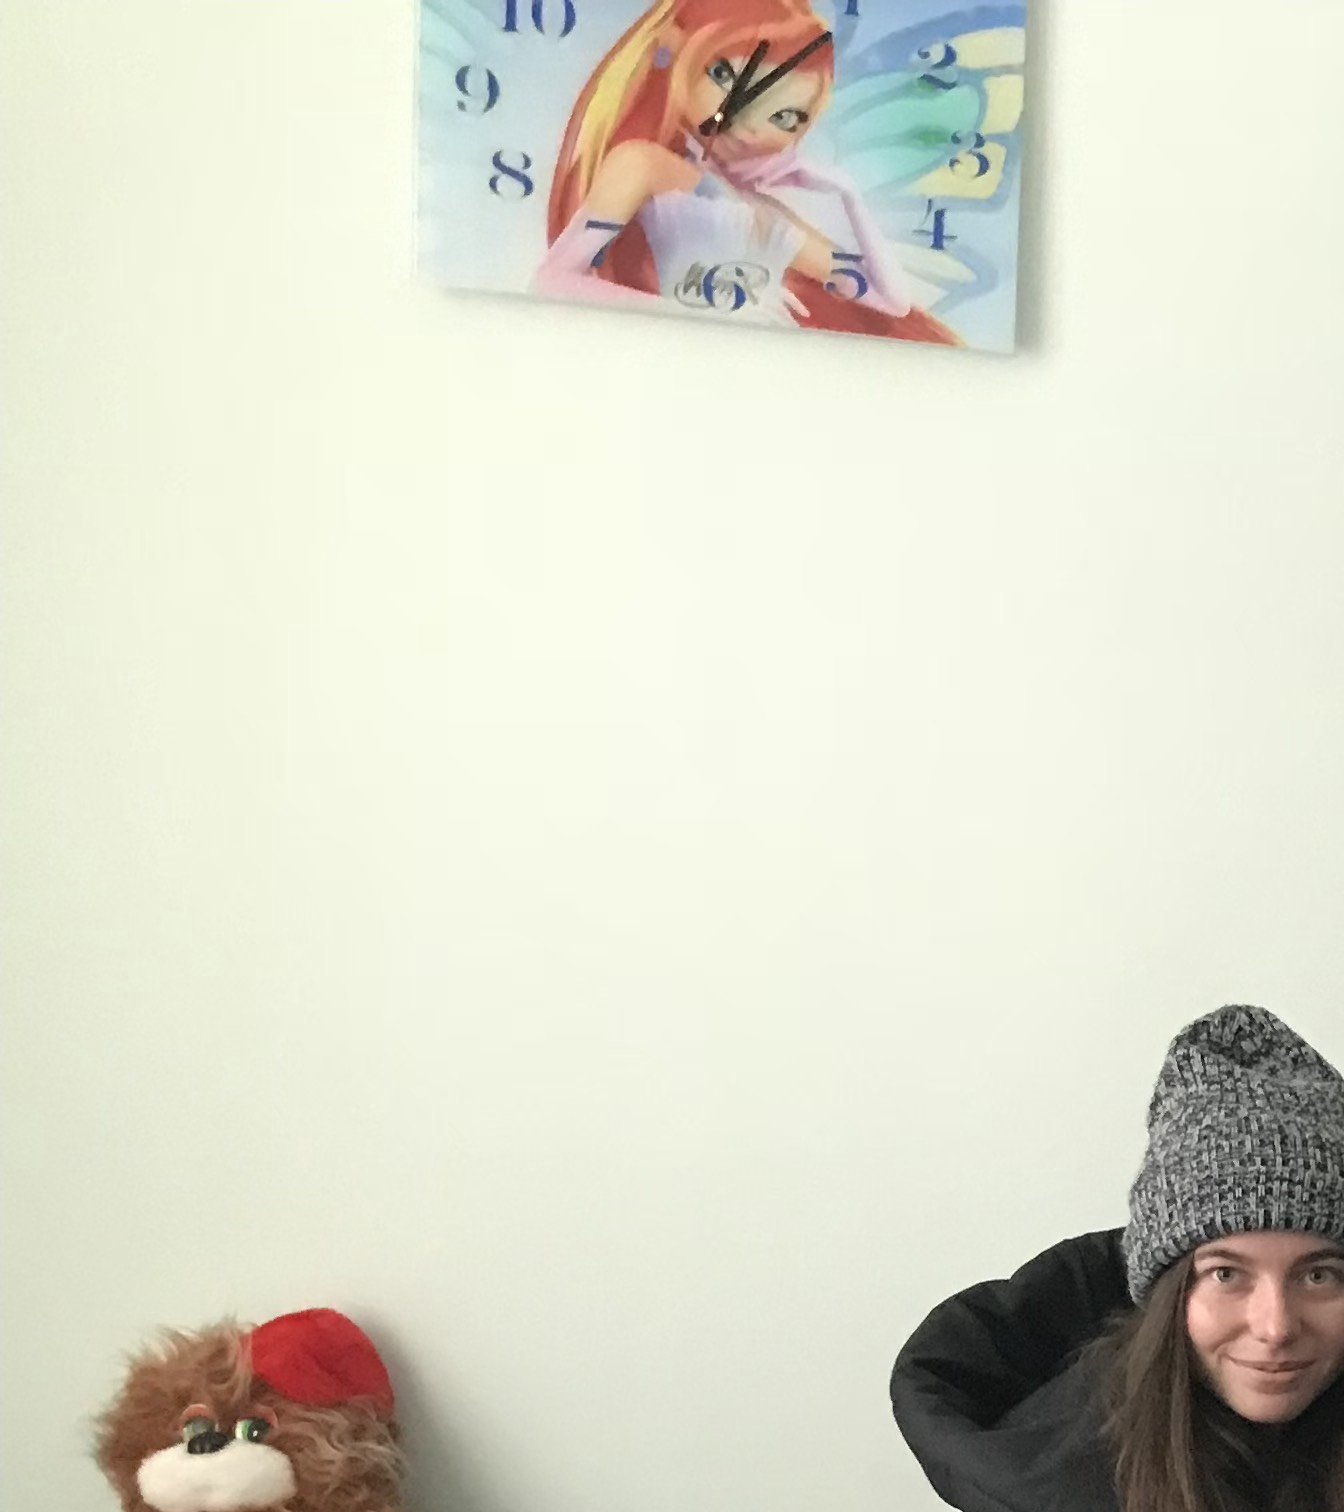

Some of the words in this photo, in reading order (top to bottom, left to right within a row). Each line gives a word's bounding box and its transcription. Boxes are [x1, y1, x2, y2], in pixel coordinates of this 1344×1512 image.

[455, 64, 500, 114] 9
[917, 42, 958, 89] 2
[489, 149, 535, 200] 8
[950, 130, 990, 179] 3
[585, 220, 625, 268] 7
[914, 200, 958, 251] 4
[827, 252, 868, 301] 5
